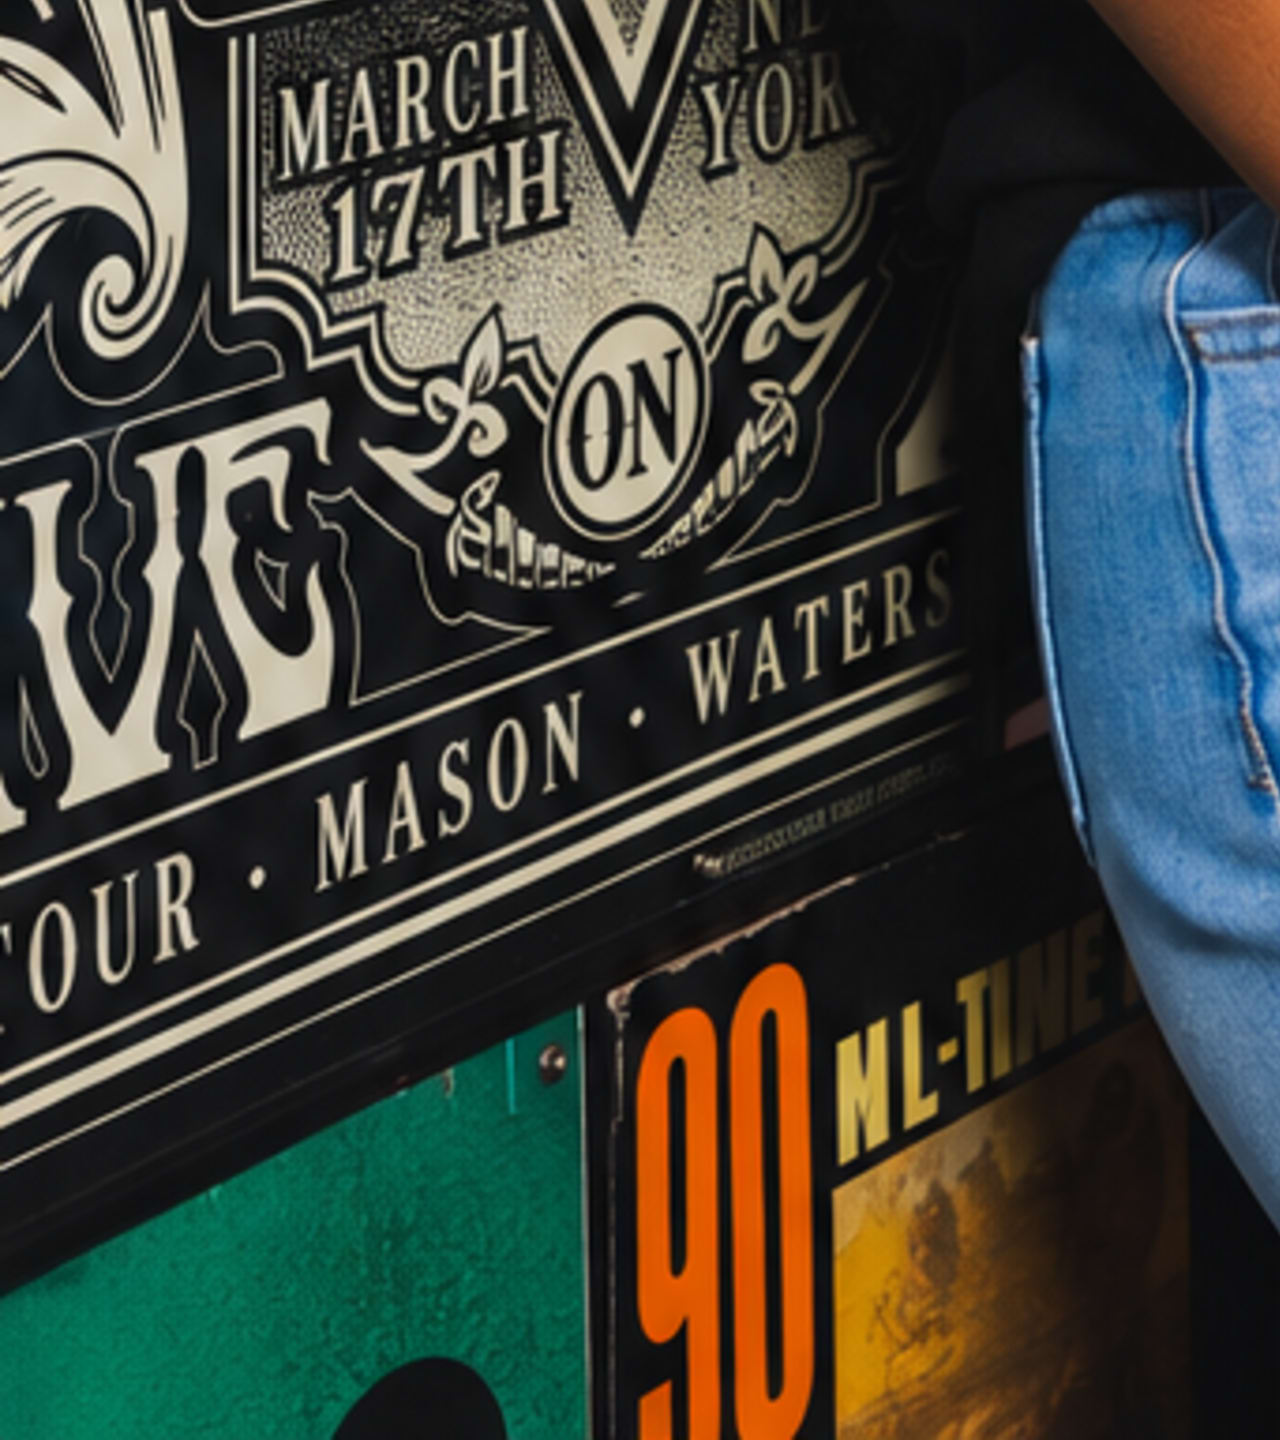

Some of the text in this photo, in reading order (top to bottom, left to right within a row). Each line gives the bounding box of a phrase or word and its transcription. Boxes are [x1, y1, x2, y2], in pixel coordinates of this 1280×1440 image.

[277, 24, 532, 183] MARCH
[327, 127, 572, 285] 17TH
[571, 347, 686, 495] ON
[0, 850, 200, 1033] OUR
[315, 690, 586, 894] MASON
[685, 548, 954, 725] WATERS
